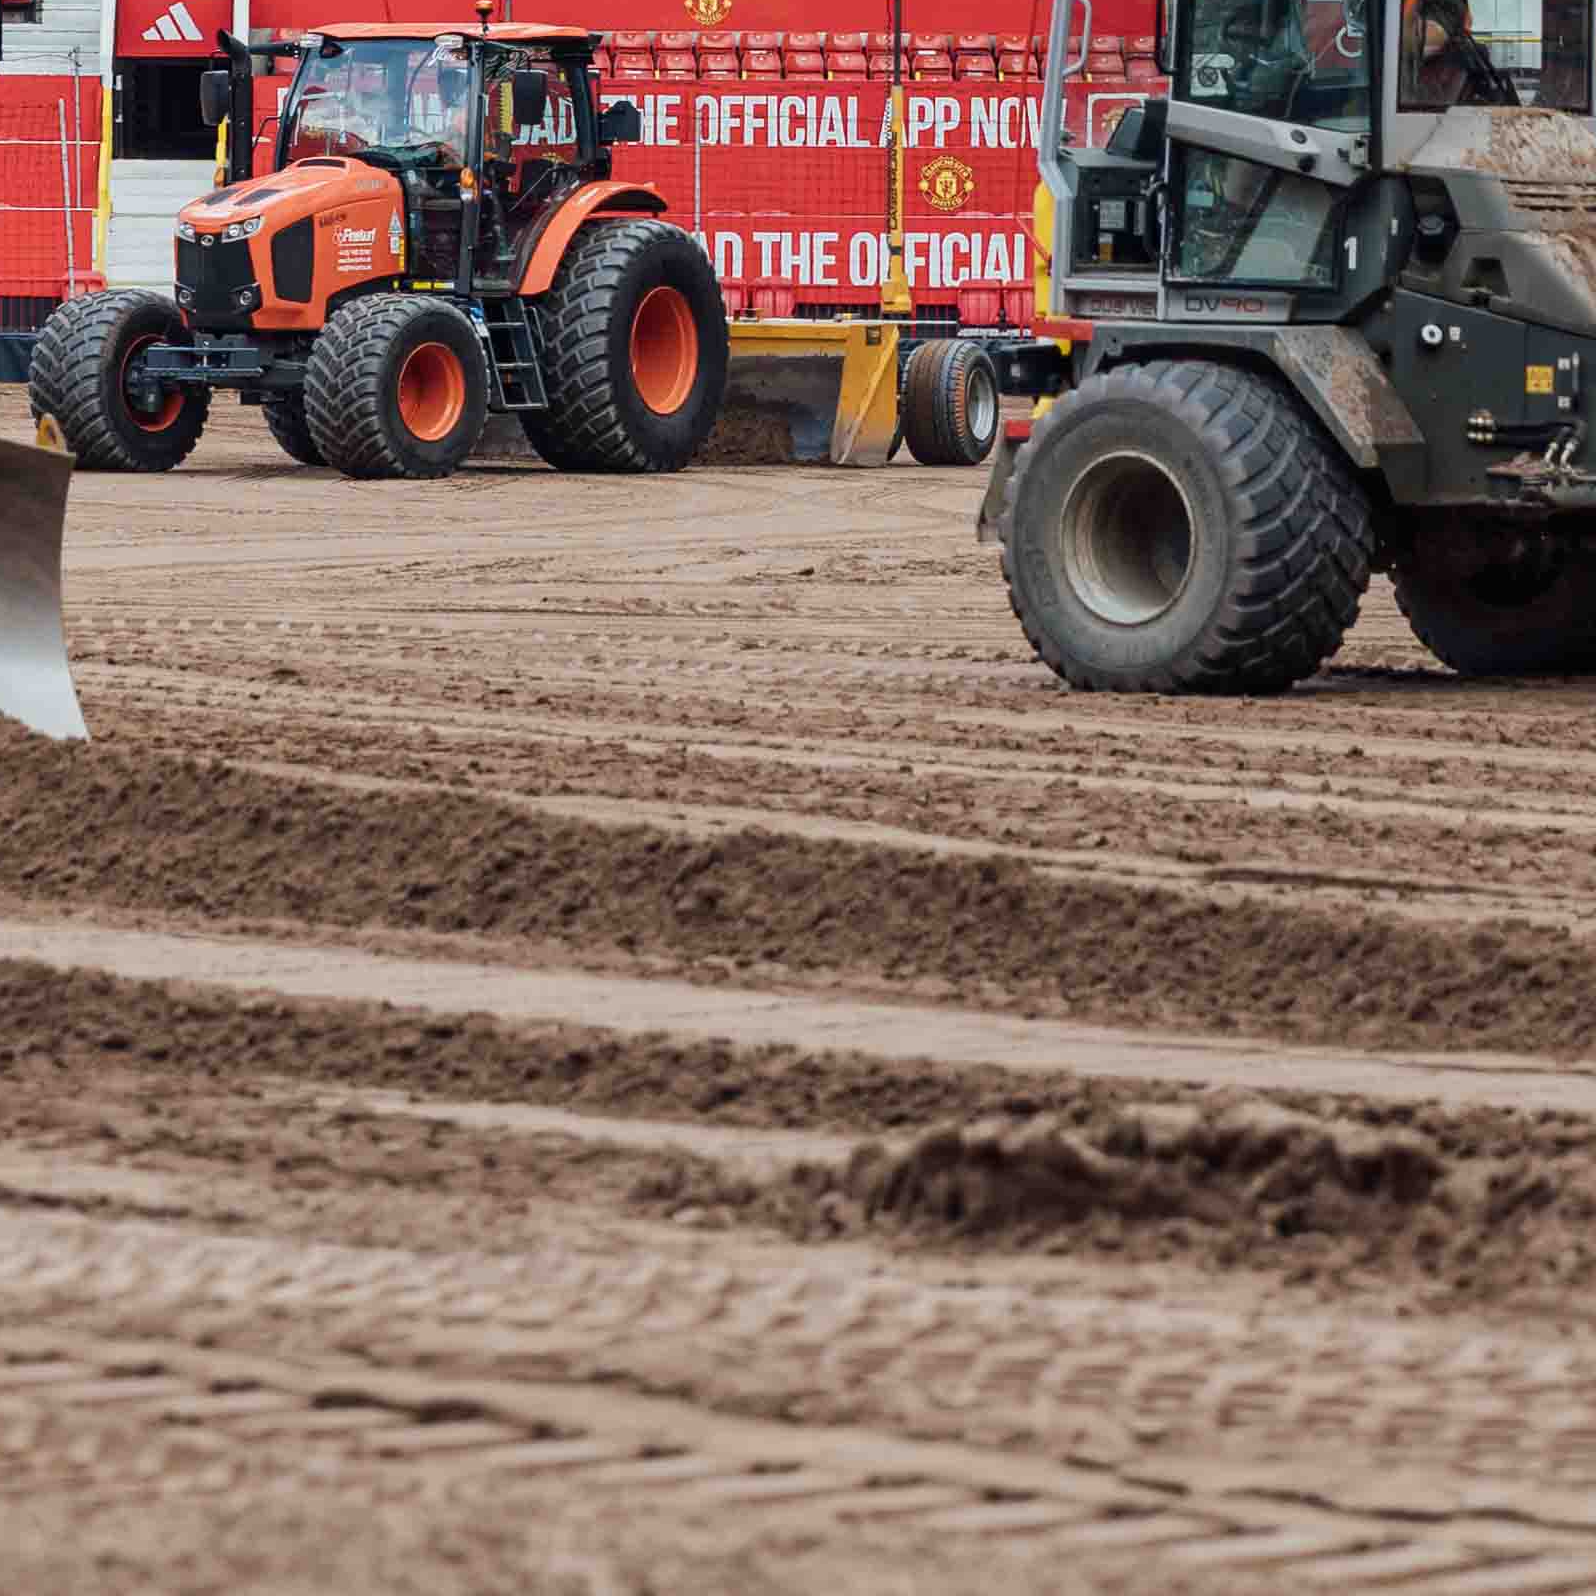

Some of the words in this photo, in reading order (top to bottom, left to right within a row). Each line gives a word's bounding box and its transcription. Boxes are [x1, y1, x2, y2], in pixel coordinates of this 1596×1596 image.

[695, 95, 870, 147] OFFICIAL
[752, 231, 839, 286] THE
[1344, 236, 1357, 271] 1
